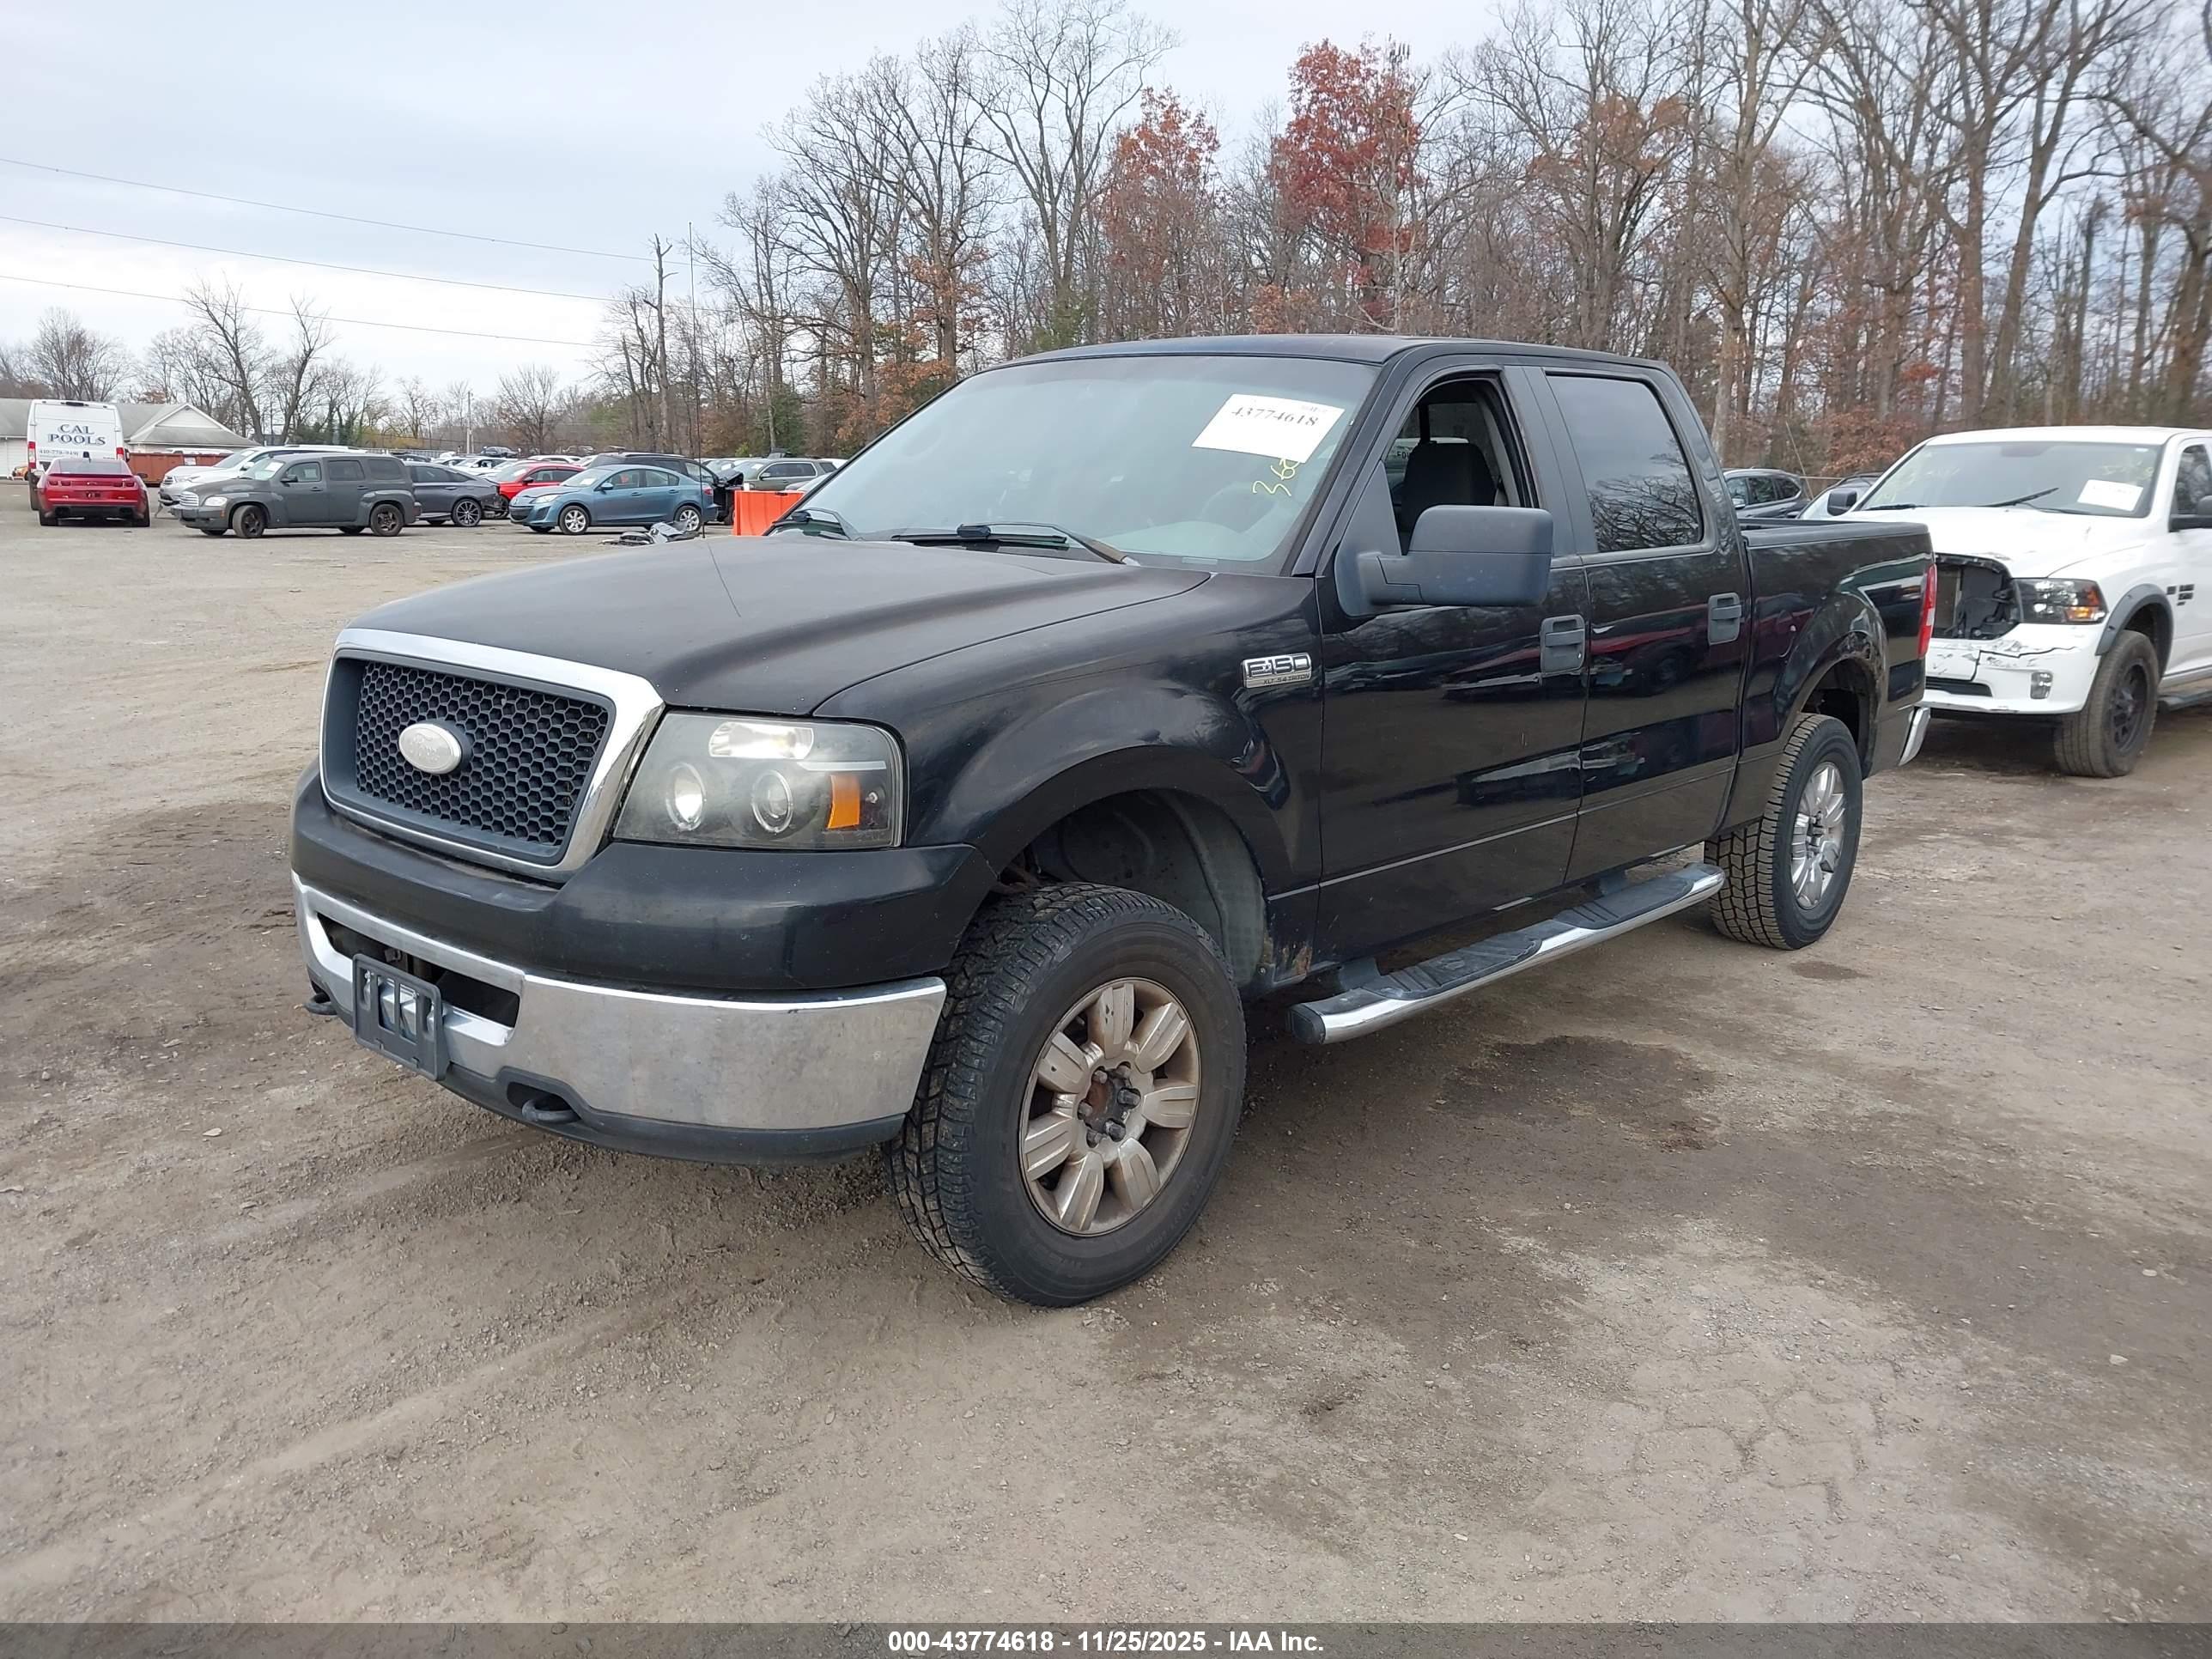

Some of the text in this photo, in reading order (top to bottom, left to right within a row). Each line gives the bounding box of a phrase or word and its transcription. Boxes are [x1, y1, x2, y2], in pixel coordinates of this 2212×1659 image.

[1231, 406, 1318, 426] 43774618
[58, 423, 94, 434] CAL
[48, 434, 106, 446] POOLS
